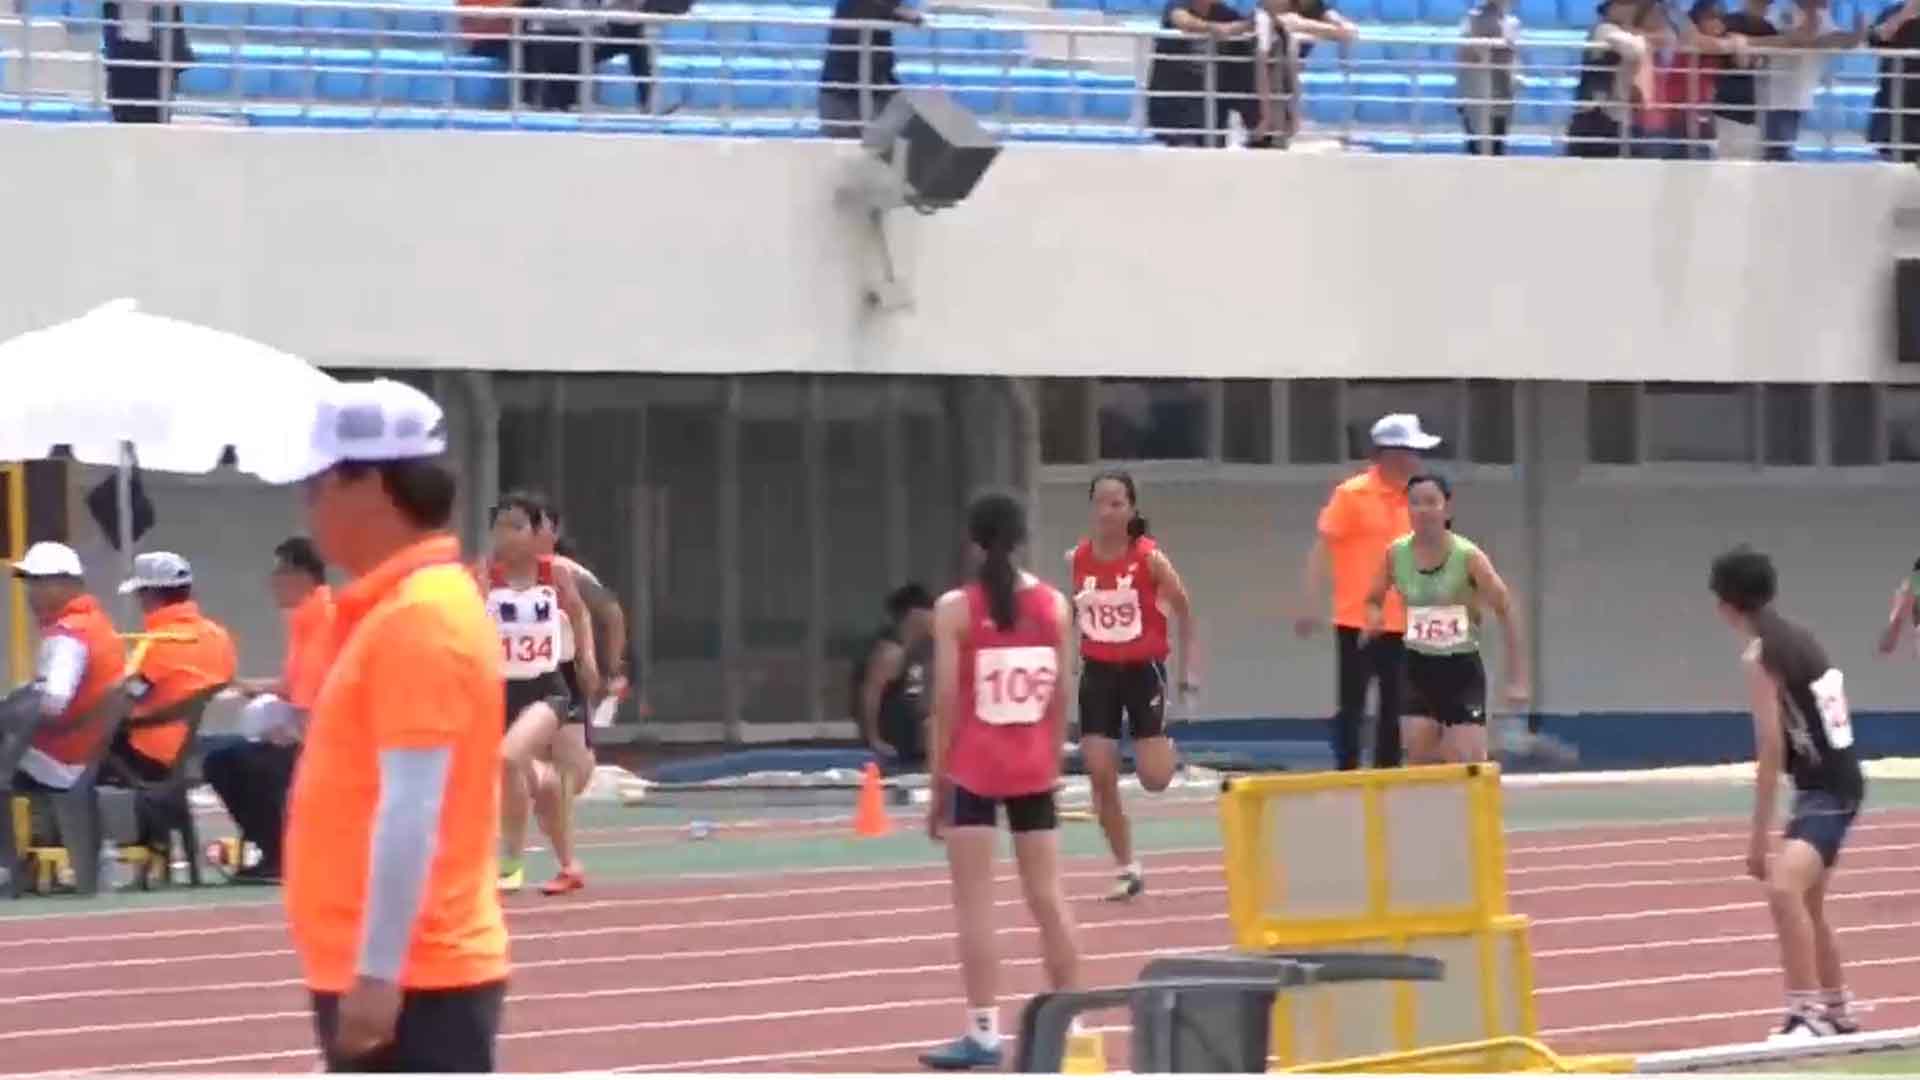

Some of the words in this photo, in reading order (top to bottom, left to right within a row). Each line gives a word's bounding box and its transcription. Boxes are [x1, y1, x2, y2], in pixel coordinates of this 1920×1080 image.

[1088, 604, 1135, 629] 189
[502, 636, 552, 662] 134
[985, 666, 1055, 703] 106
